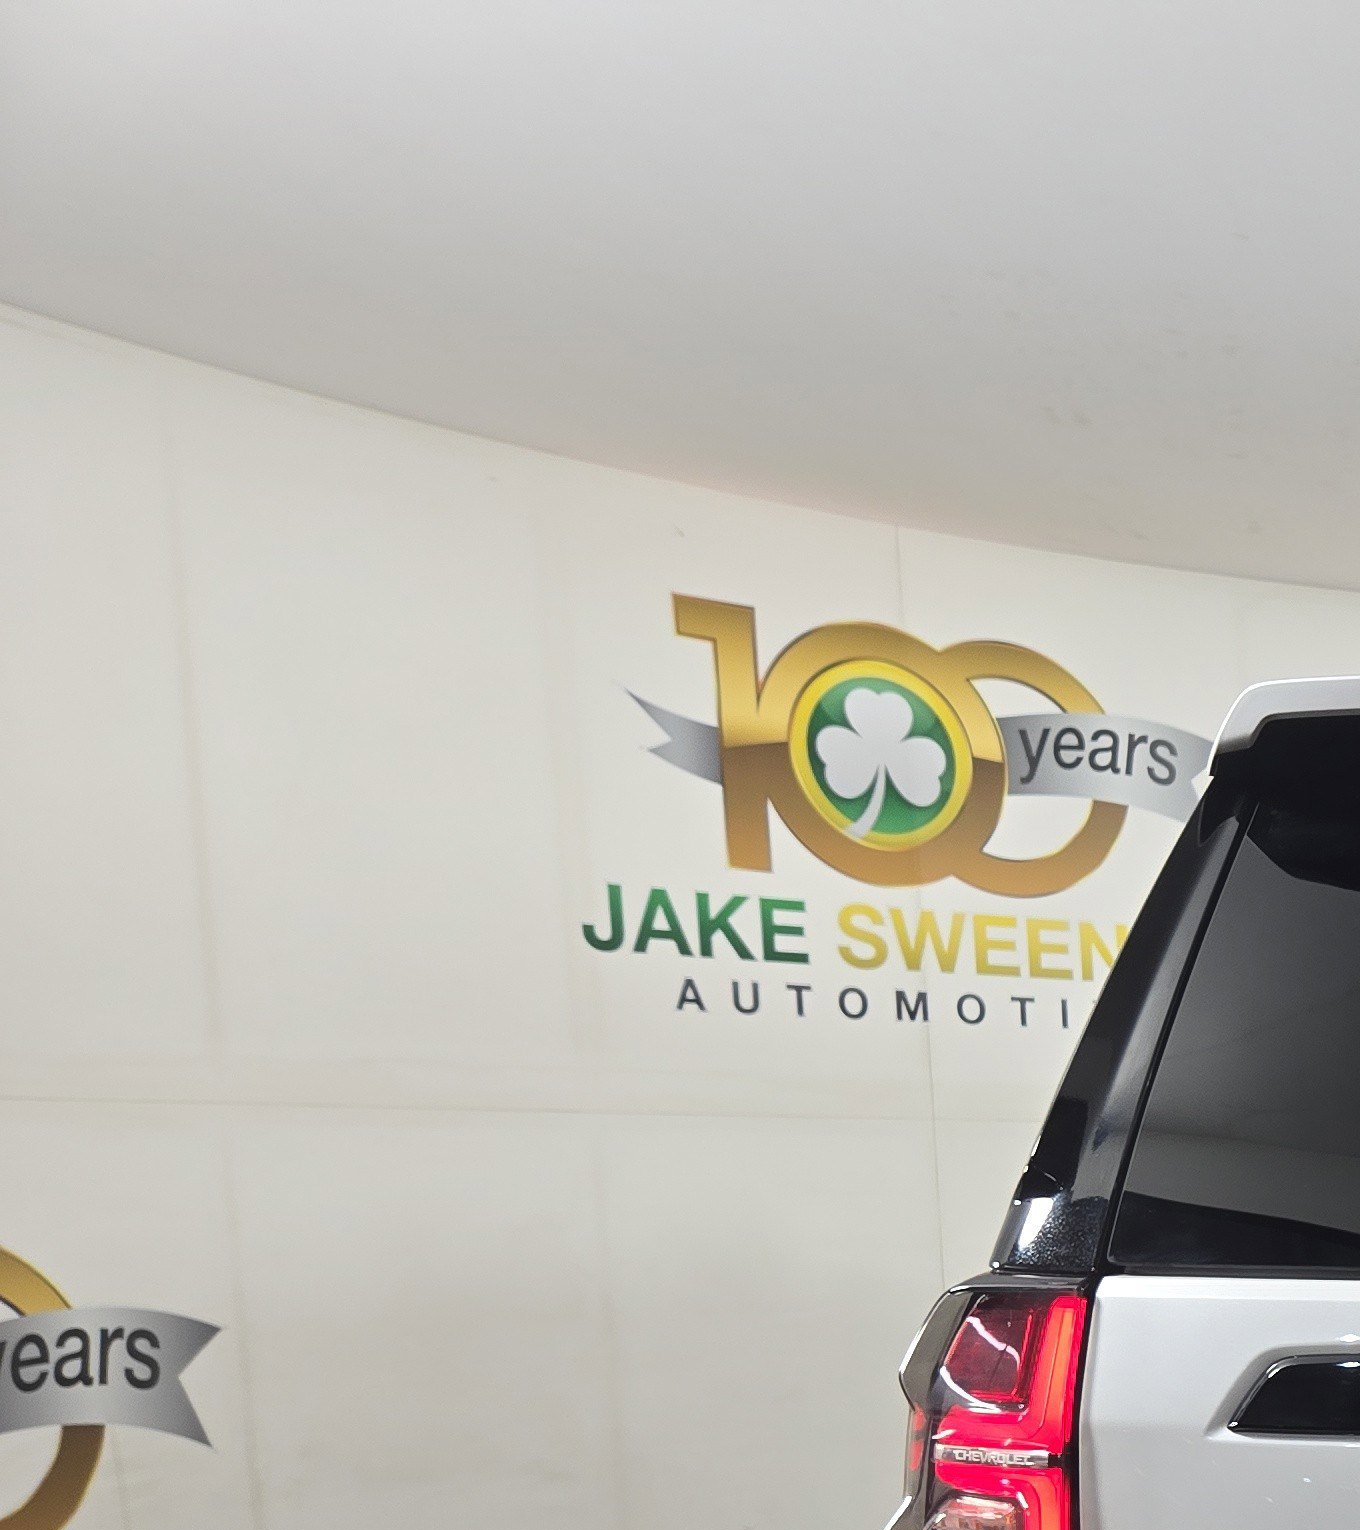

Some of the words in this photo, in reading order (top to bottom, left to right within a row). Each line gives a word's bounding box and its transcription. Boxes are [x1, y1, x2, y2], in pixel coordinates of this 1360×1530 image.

[671, 593, 1129, 899] 100
[1017, 724, 1179, 785] years
[582, 881, 811, 966] JAKE
[838, 902, 1129, 982] SWEEN
[676, 977, 1069, 1029] AUTOMOTI
[0, 1327, 160, 1393] ears
[953, 1449, 1033, 1466] CHEVROLET
